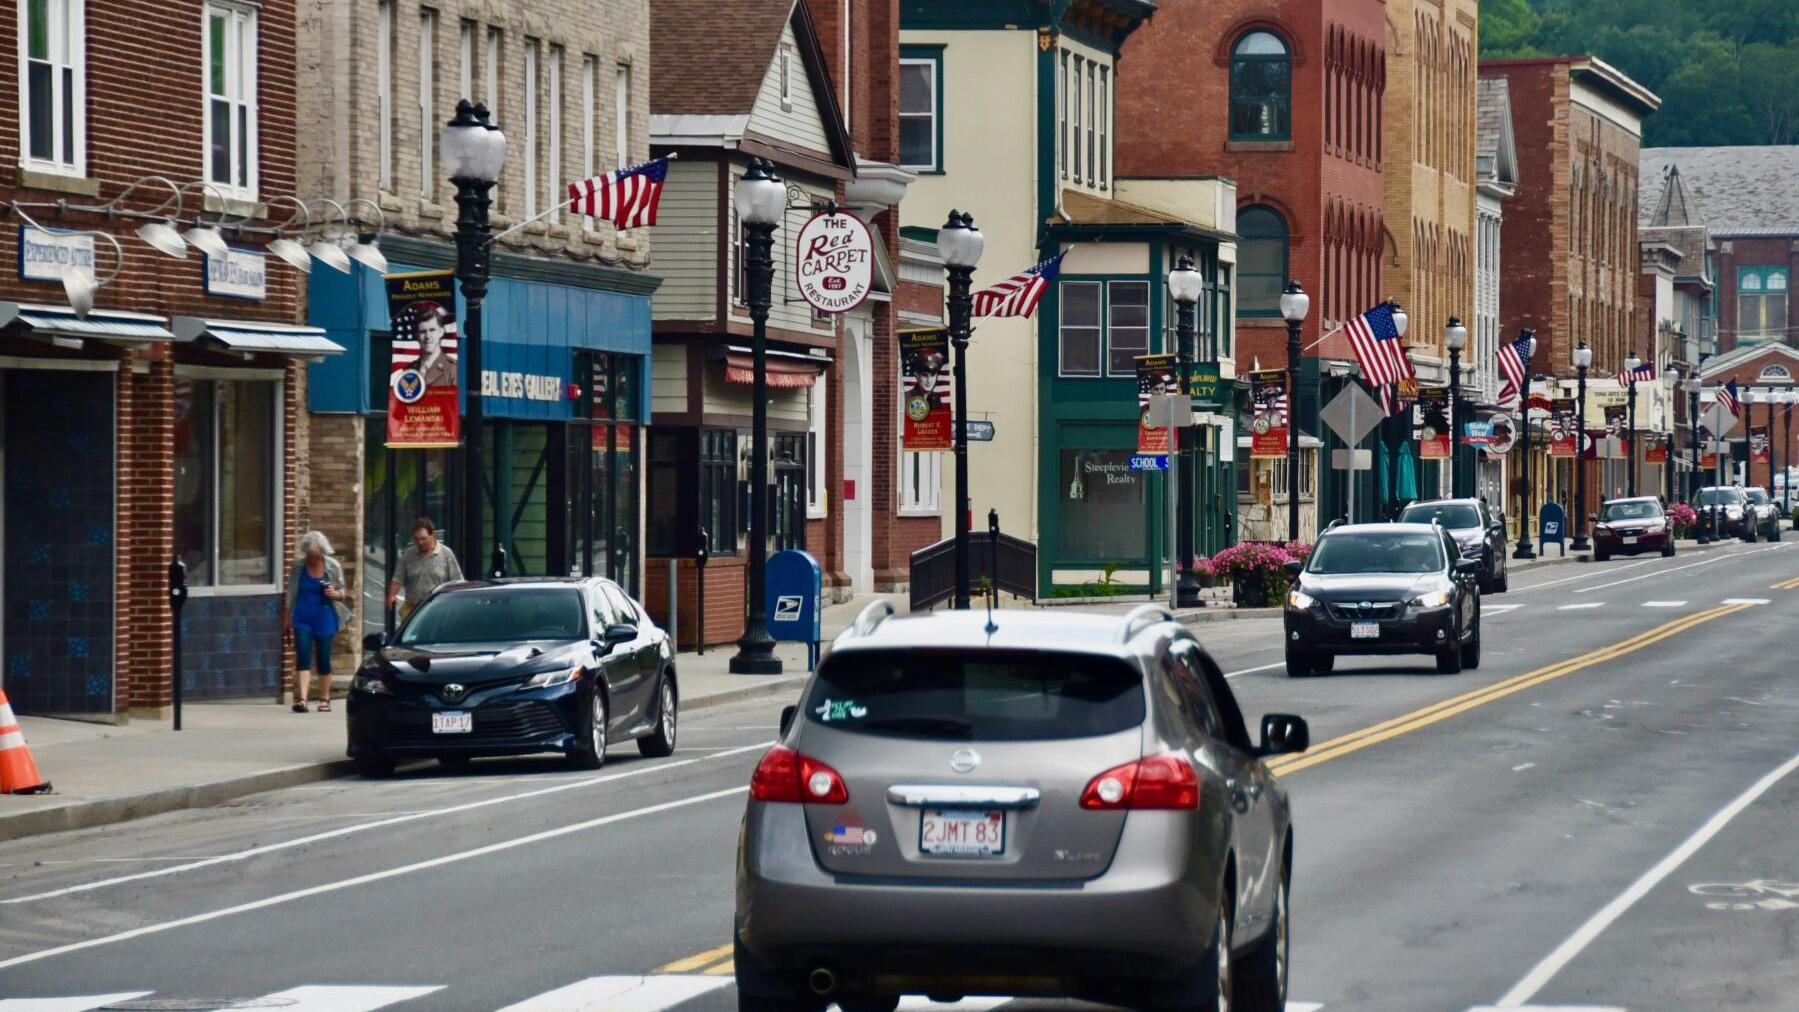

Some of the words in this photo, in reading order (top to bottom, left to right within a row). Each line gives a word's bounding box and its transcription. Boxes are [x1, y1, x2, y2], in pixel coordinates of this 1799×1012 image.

[823, 219, 847, 229] THE
[803, 230, 854, 261] Red
[802, 249, 868, 277] CARPET
[403, 280, 440, 291] ADAMS
[804, 282, 865, 308] RESTAURANT
[480, 370, 500, 397] EAL
[501, 371, 523, 399] EYES
[524, 373, 561, 402] GALLERY
[406, 406, 441, 414] WILLIAM
[404, 415, 444, 423] LEMANSKI
[1085, 461, 1130, 473] Steeplevie
[1131, 457, 1158, 468] SCHOOL
[1106, 473, 1137, 486] Realty
[924, 820, 970, 843] 2JMT
[975, 822, 999, 844] 83
